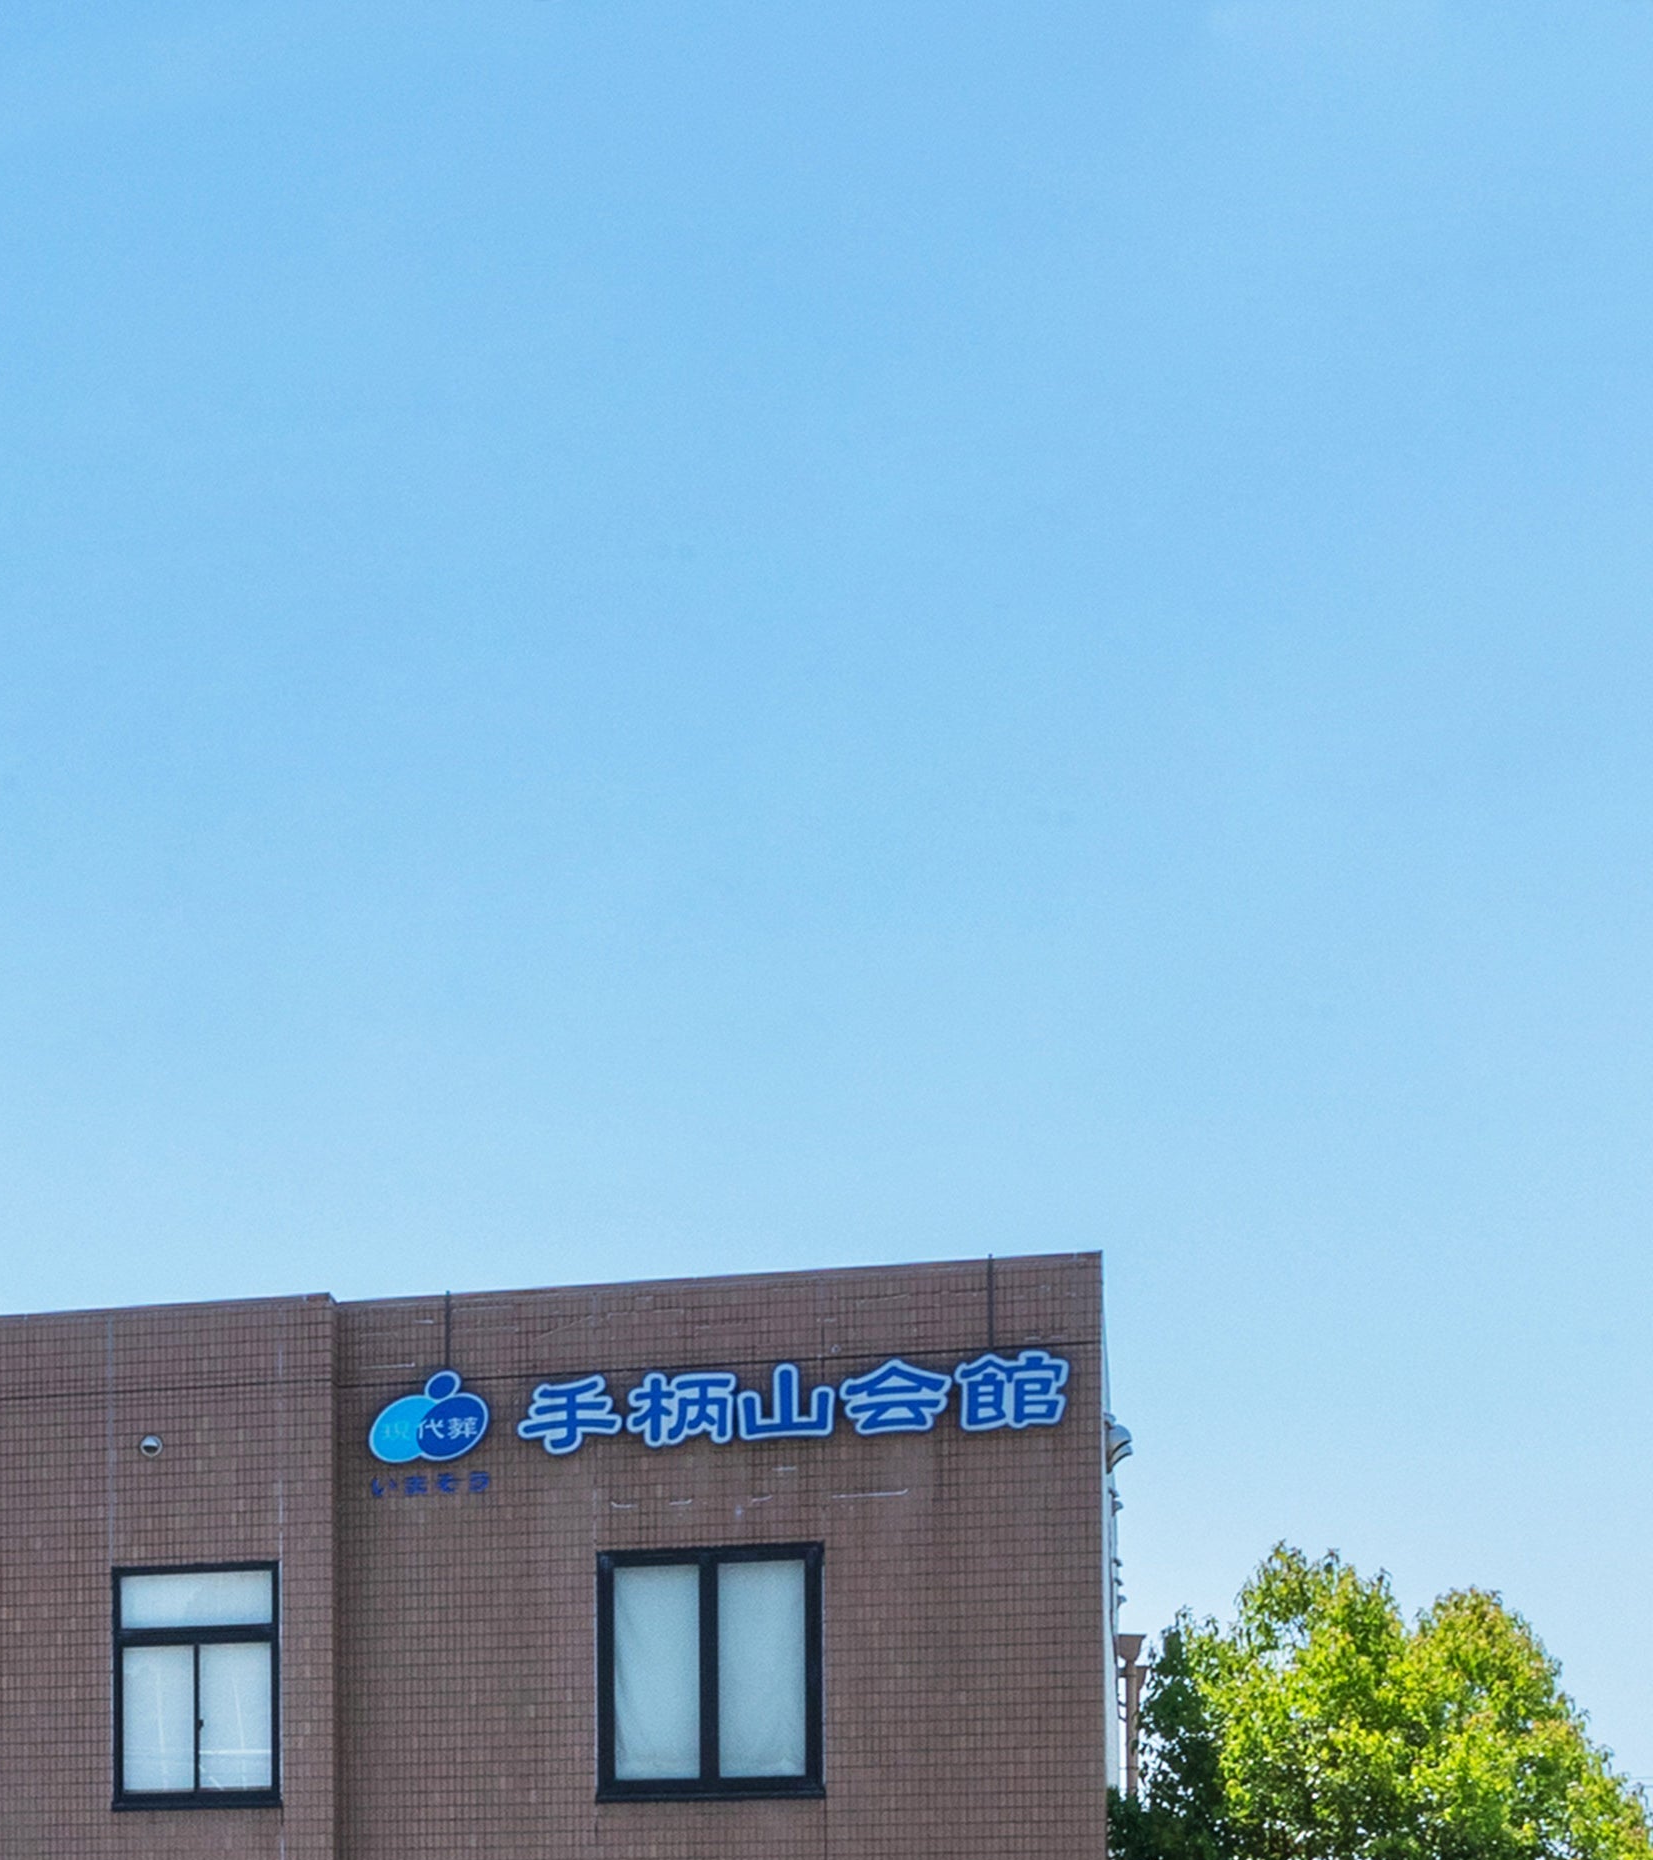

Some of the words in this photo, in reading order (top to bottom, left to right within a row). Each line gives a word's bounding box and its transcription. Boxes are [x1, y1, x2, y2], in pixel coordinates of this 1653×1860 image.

[517, 1349, 1070, 1456] 手柄山会館
[380, 1416, 478, 1440] 現代葬
[371, 1471, 490, 1498] いまそう
